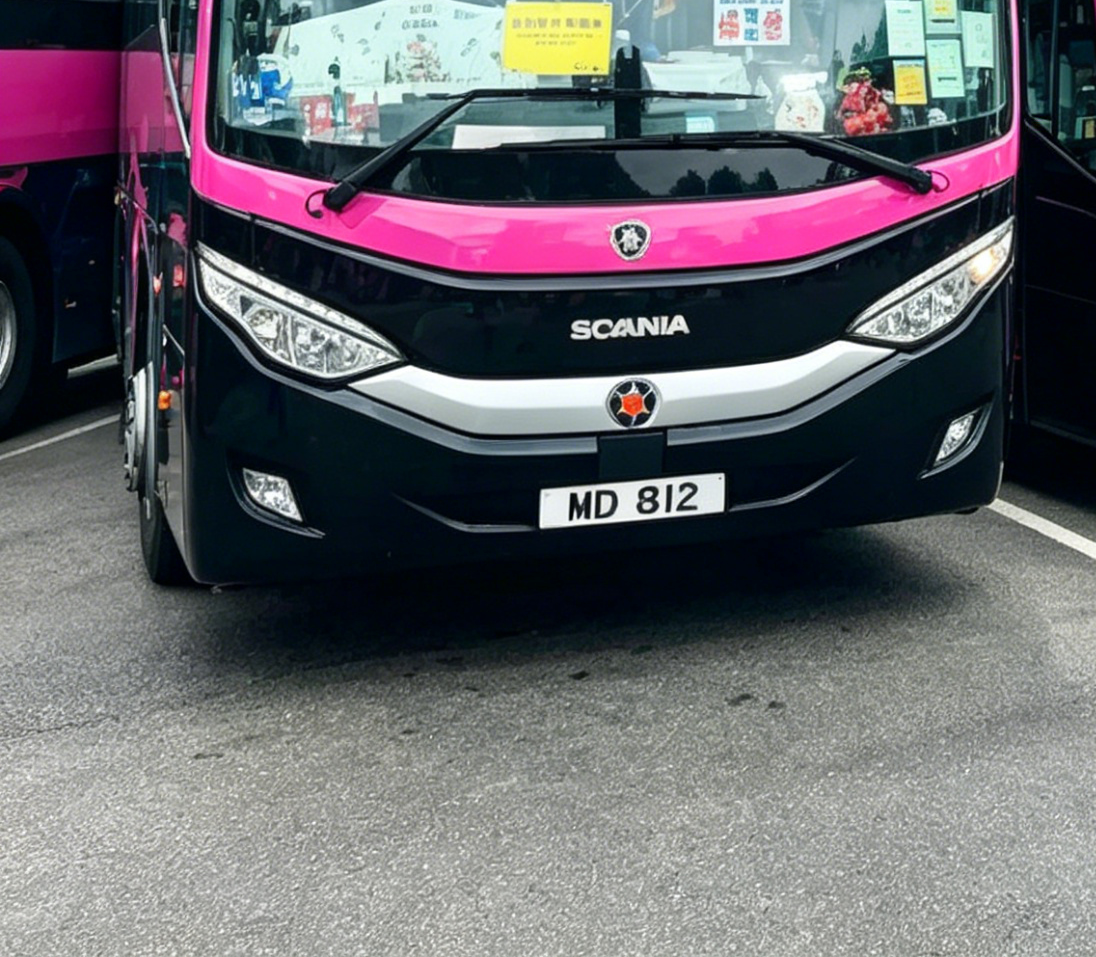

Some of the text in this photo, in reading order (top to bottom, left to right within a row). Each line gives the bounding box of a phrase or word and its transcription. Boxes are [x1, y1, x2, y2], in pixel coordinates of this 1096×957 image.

[570, 315, 690, 340] SCANIA
[568, 482, 699, 521] MD 812
